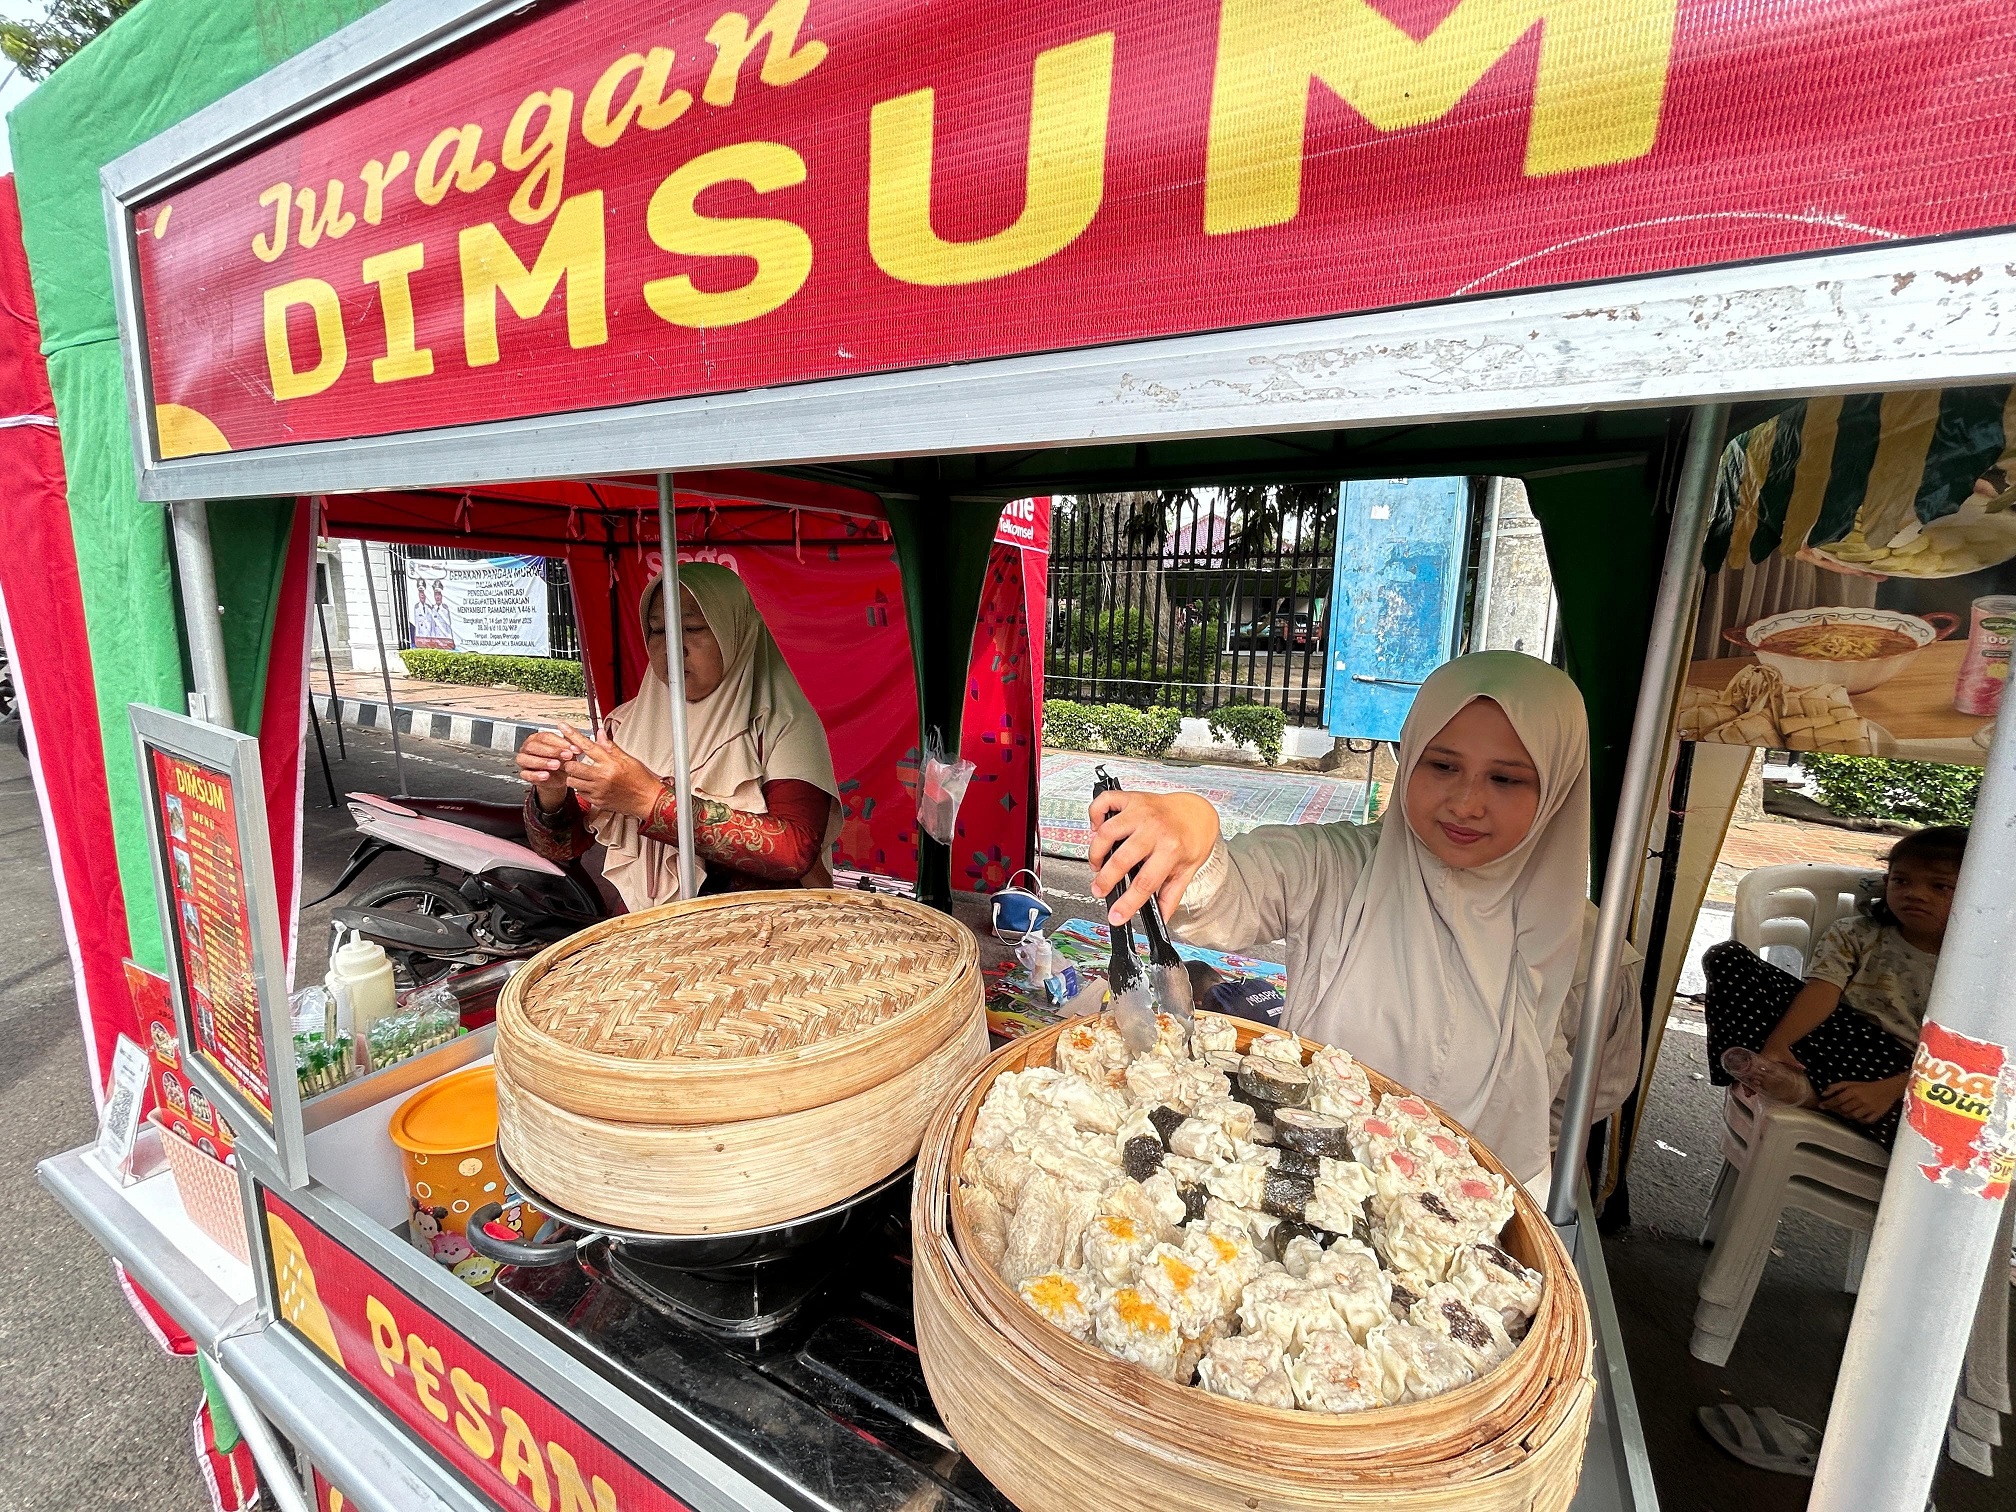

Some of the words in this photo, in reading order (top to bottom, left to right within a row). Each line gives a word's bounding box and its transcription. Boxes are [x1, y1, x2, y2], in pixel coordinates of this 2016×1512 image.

[251, 0, 828, 263] Juragan
[263, 0, 1677, 402] DIMSUM
[999, 516, 1034, 540] Telkomsel
[449, 570, 481, 580] GERAKAN
[483, 568, 511, 579] PANGAN
[497, 597, 529, 605] BANGKALAN
[504, 588, 525, 597] INFLASI
[176, 767, 225, 812] DIMSUM
[193, 811, 214, 830] MENU
[366, 1295, 617, 1512] PESAN
